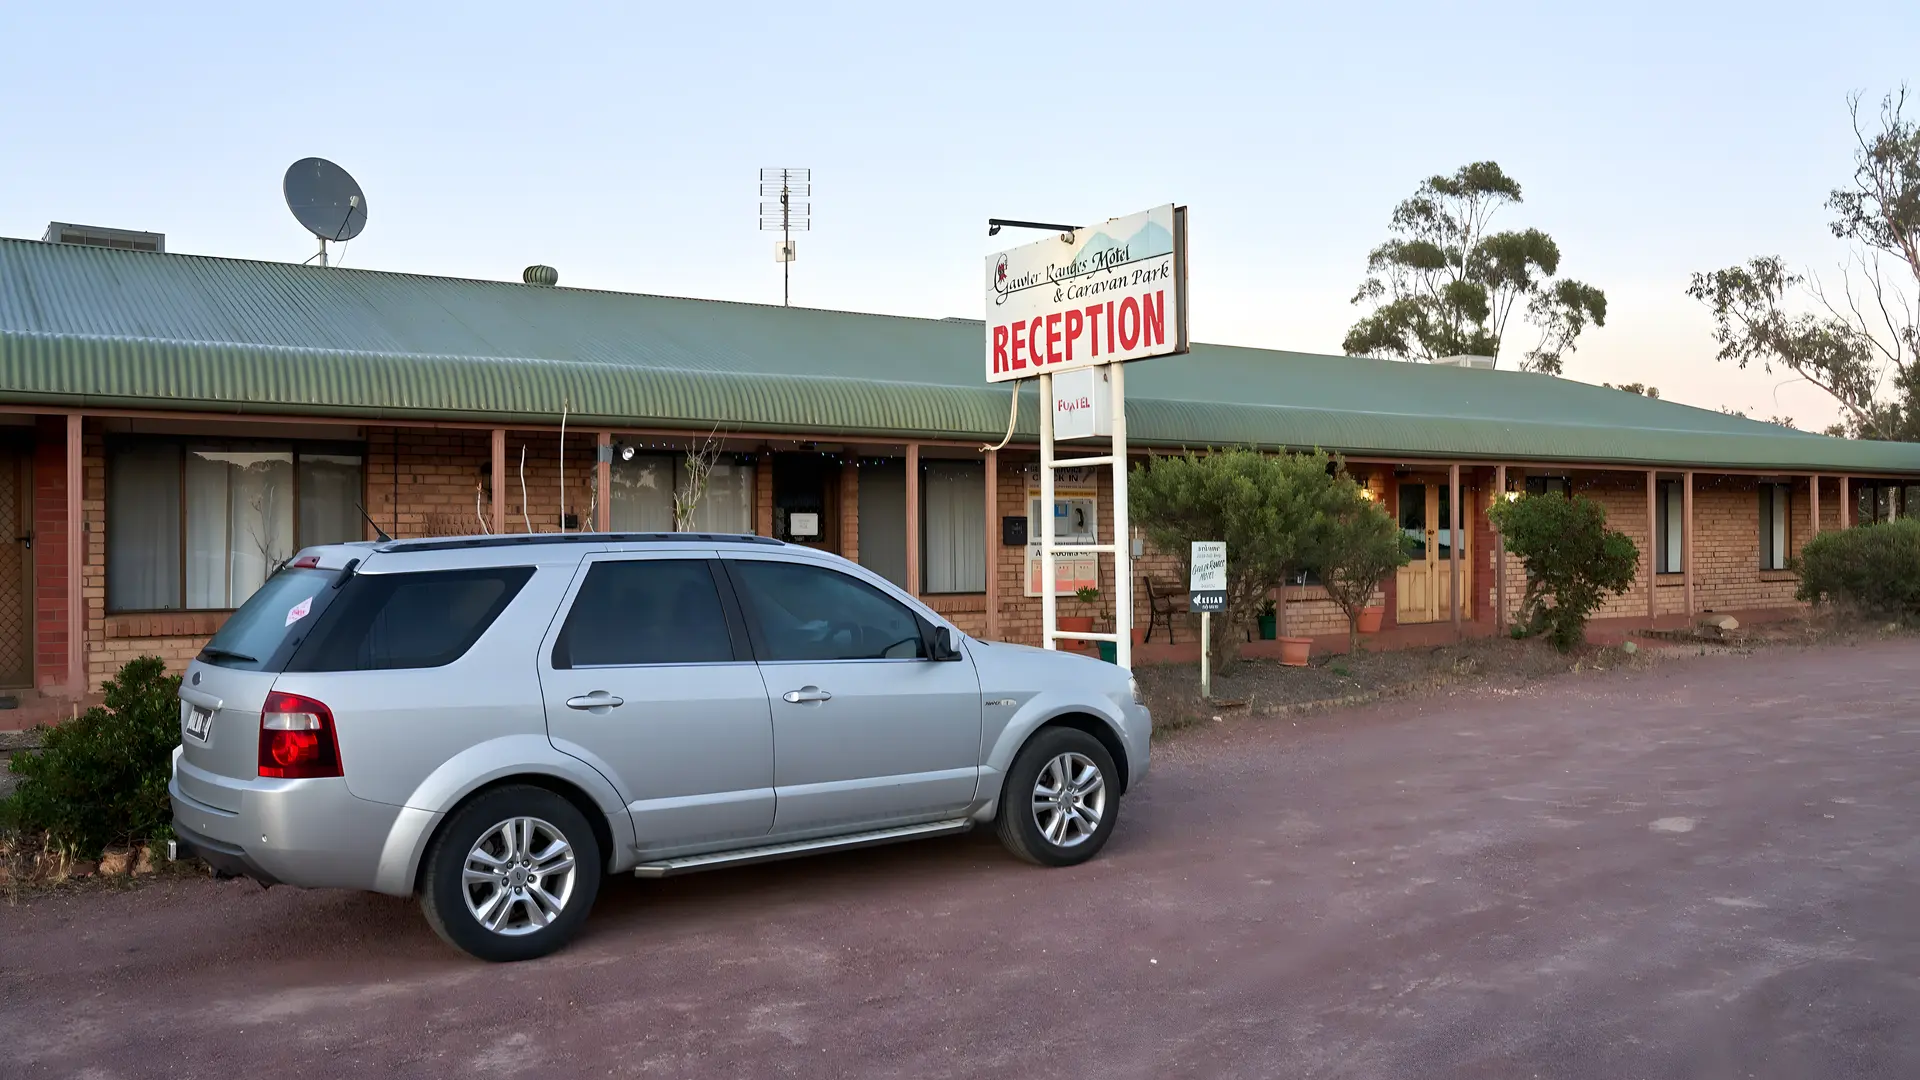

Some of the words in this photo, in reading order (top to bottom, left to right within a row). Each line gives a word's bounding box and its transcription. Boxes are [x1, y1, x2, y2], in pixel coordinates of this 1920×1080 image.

[988, 254, 1041, 305] Gawler
[1046, 259, 1088, 285] Ranges
[1087, 244, 1130, 279] Motel
[1053, 288, 1064, 303] &
[1067, 275, 1128, 300] Caravan
[1132, 261, 1169, 285] Park
[993, 290, 1164, 374] RECEPTION
